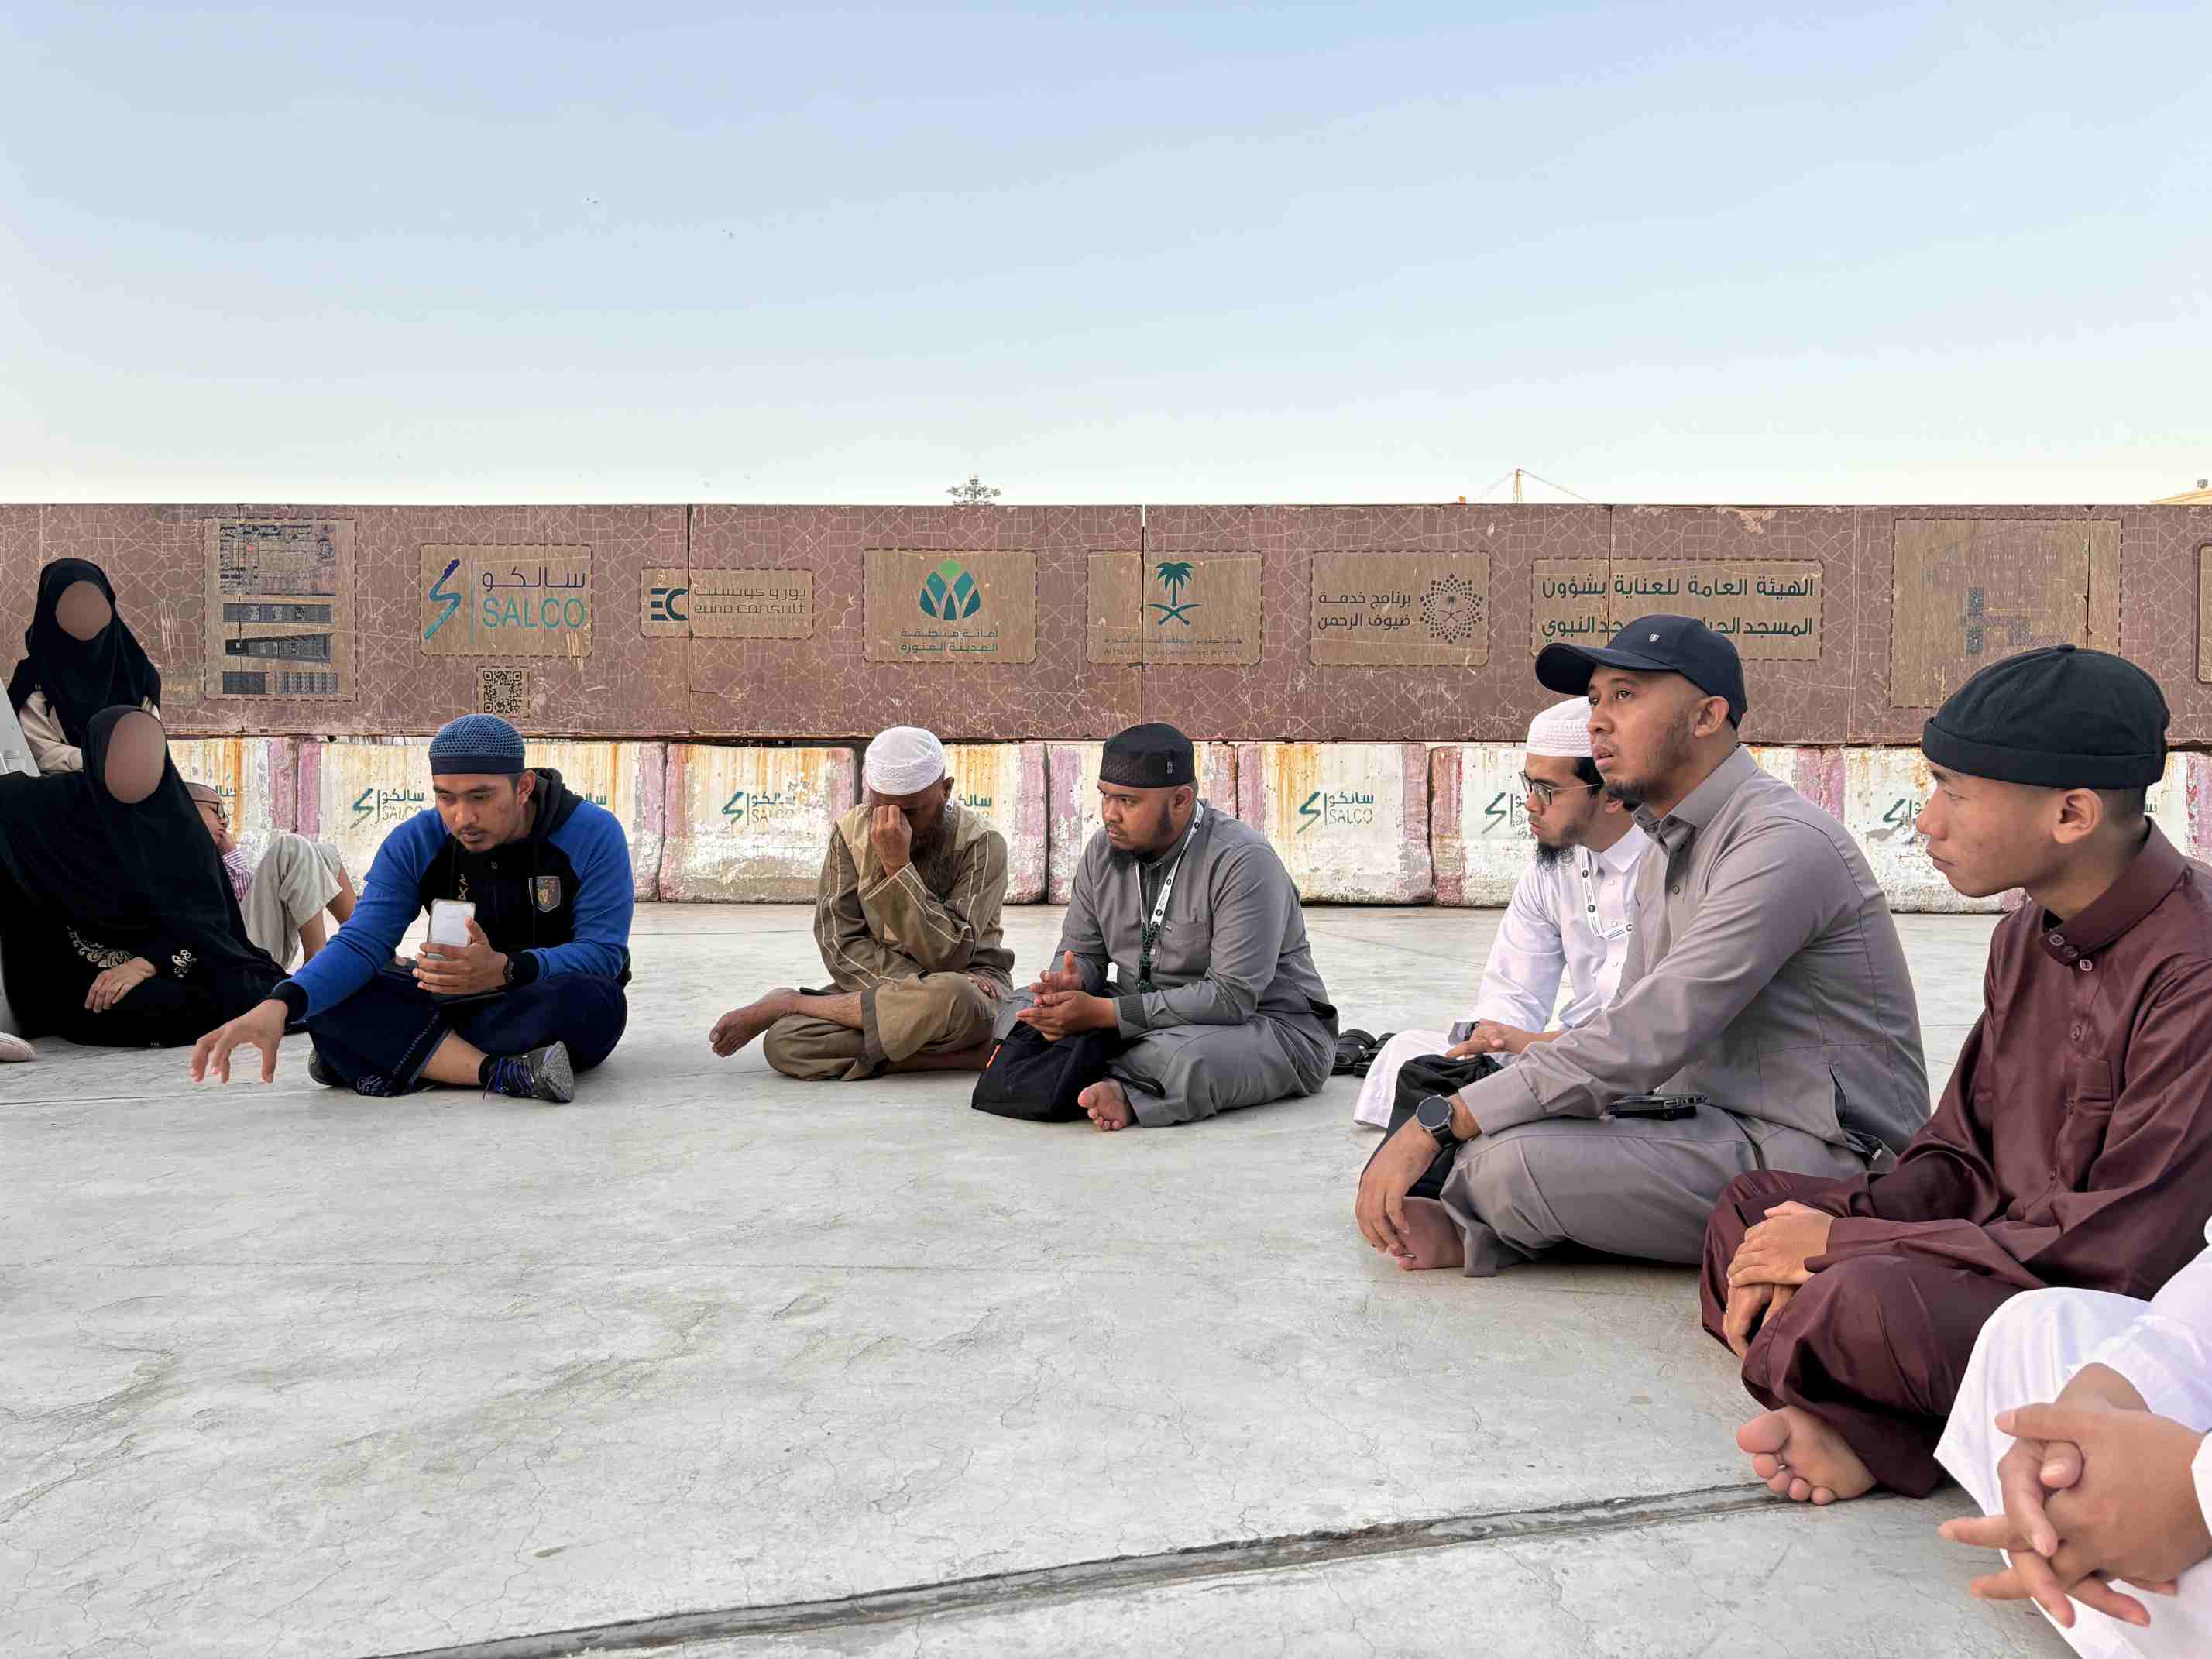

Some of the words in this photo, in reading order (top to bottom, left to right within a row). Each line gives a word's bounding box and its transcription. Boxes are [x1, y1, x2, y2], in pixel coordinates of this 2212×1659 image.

[482, 566, 586, 592] سالكو
[1542, 573, 1606, 599] بشؤون
[1614, 574, 1680, 599] للعناية
[1688, 575, 1748, 597] العامة
[1757, 575, 1813, 600] الهيئة
[1318, 591, 1366, 604] خدمة
[1370, 590, 1411, 609] برنامج
[483, 596, 586, 629] SALCO
[737, 603, 806, 614] consult
[1318, 613, 1363, 631] الرحمن
[1368, 613, 1410, 631] ضيوف
[1542, 616, 1595, 643] النبوي
[1743, 617, 1812, 639] المسجد
[381, 788, 424, 805] سالكو
[958, 792, 991, 807] سالك
[1328, 790, 1374, 807] سالكو
[1329, 808, 1373, 825] SALCO
